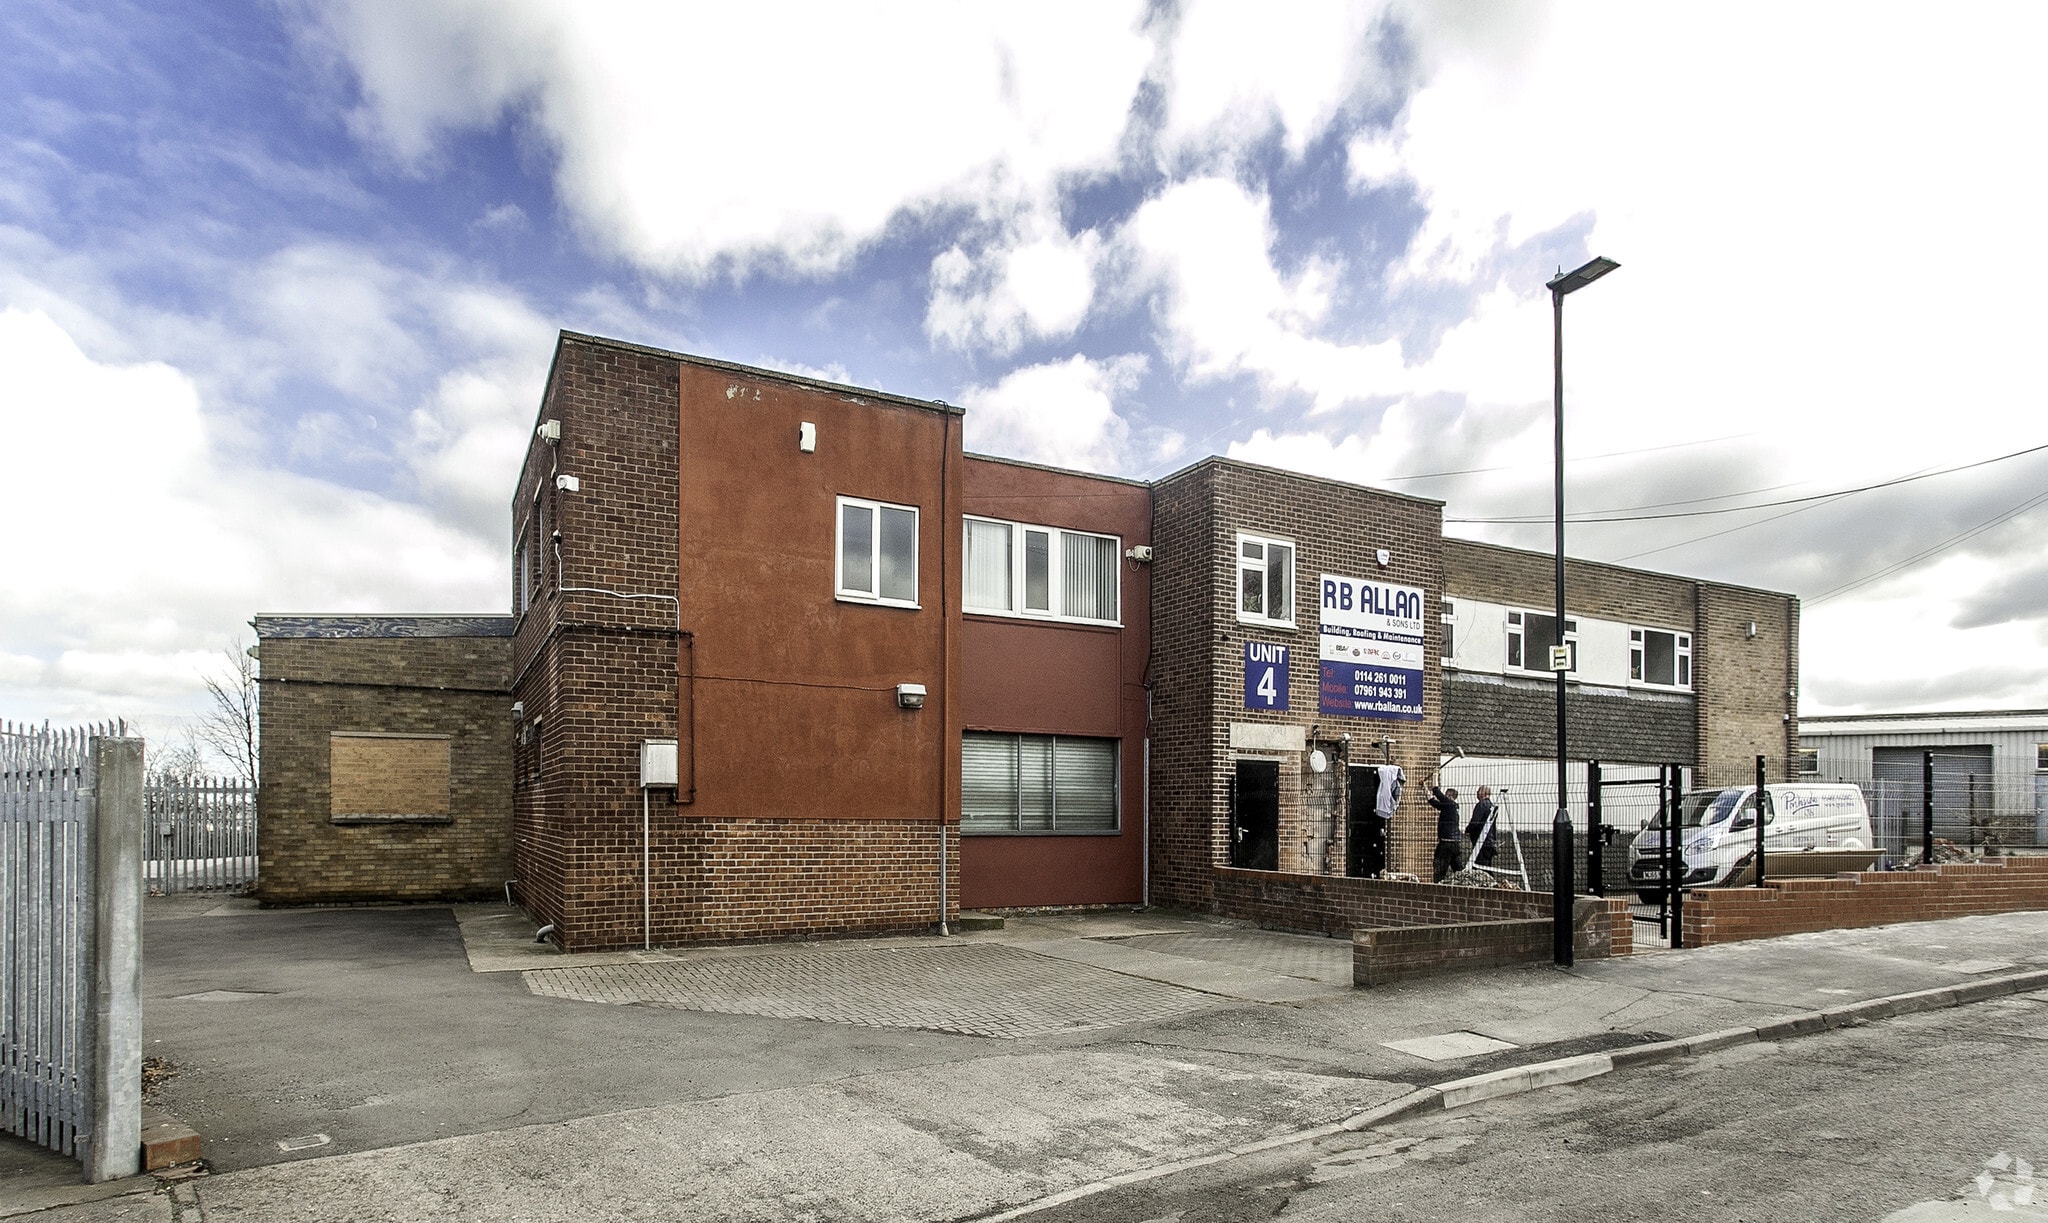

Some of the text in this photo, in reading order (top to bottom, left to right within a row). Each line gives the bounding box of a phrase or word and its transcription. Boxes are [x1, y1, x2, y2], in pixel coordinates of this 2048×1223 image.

[1323, 579, 1420, 620] RB ALLAN
[1386, 618, 1421, 630] & SONS LTD
[1323, 624, 1421, 645] Building, Roofing & Maintenance
[1250, 643, 1286, 664] UNIT
[1257, 667, 1277, 705] 4
[1354, 670, 1373, 682] 0114
[1374, 672, 1387, 684] 261
[1389, 674, 1406, 685] 0011
[1354, 684, 1377, 697] 07961
[1378, 686, 1393, 698] 943
[1394, 688, 1407, 699] 391
[1354, 701, 1423, 714] www.rballan.co.uk
